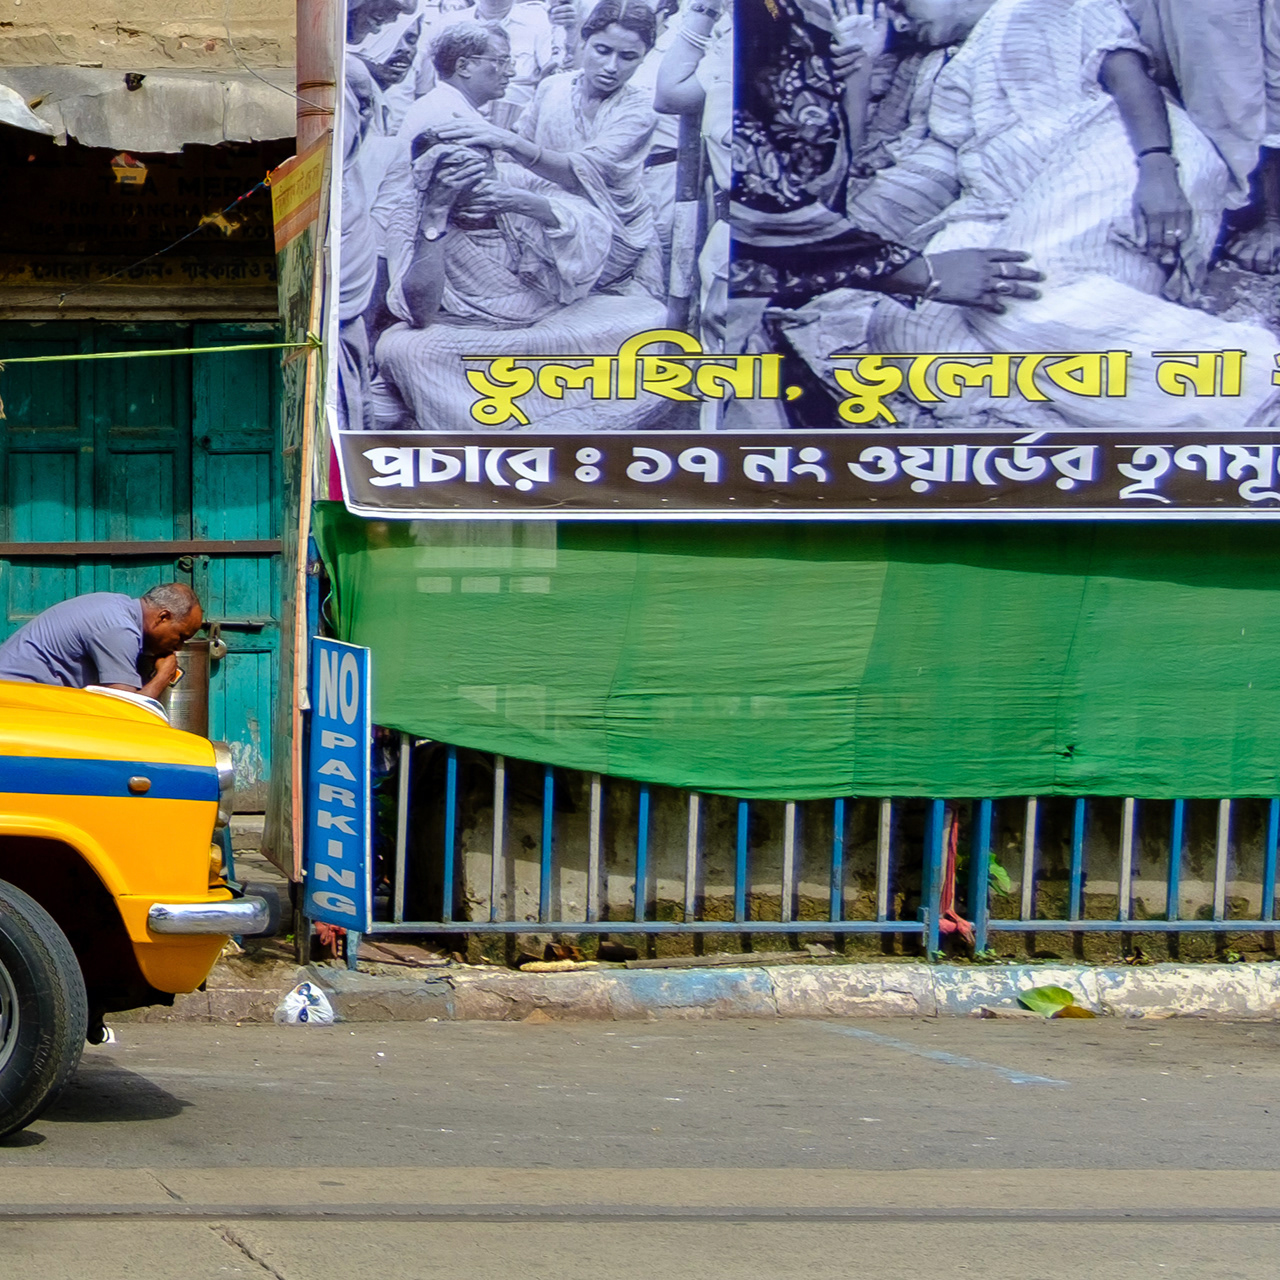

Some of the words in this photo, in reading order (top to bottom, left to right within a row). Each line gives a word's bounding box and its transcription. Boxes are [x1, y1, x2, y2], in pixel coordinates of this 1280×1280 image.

[1151, 349, 1246, 398] না
[362, 445, 554, 491] প্রচারে
[626, 446, 720, 483] ১৭
[739, 446, 828, 483] নং
[846, 431, 1099, 494] ওয়ার্ডের
[1115, 444, 1280, 504] তৃণমূ
[318, 648, 360, 725] NO
[311, 729, 359, 917] PARKING
